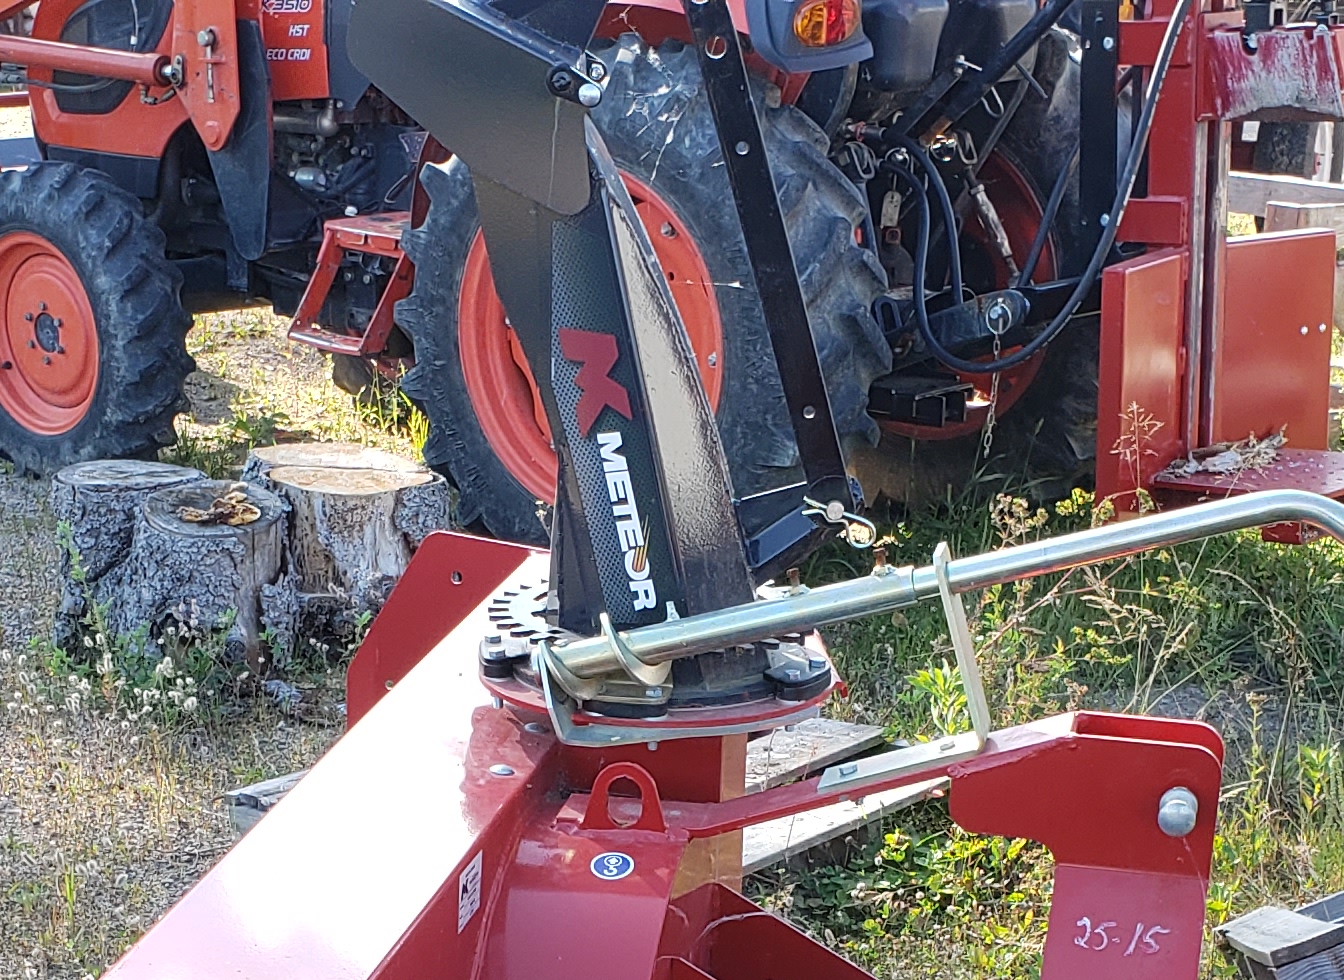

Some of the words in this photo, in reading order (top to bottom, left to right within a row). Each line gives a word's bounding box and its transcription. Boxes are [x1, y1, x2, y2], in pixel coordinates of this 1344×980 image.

[288, 24, 311, 37] HST
[266, 48, 287, 61] ECO
[287, 48, 312, 61] CRDI
[596, 431, 658, 613] METEOR
[1073, 916, 1172, 957] 25-15
